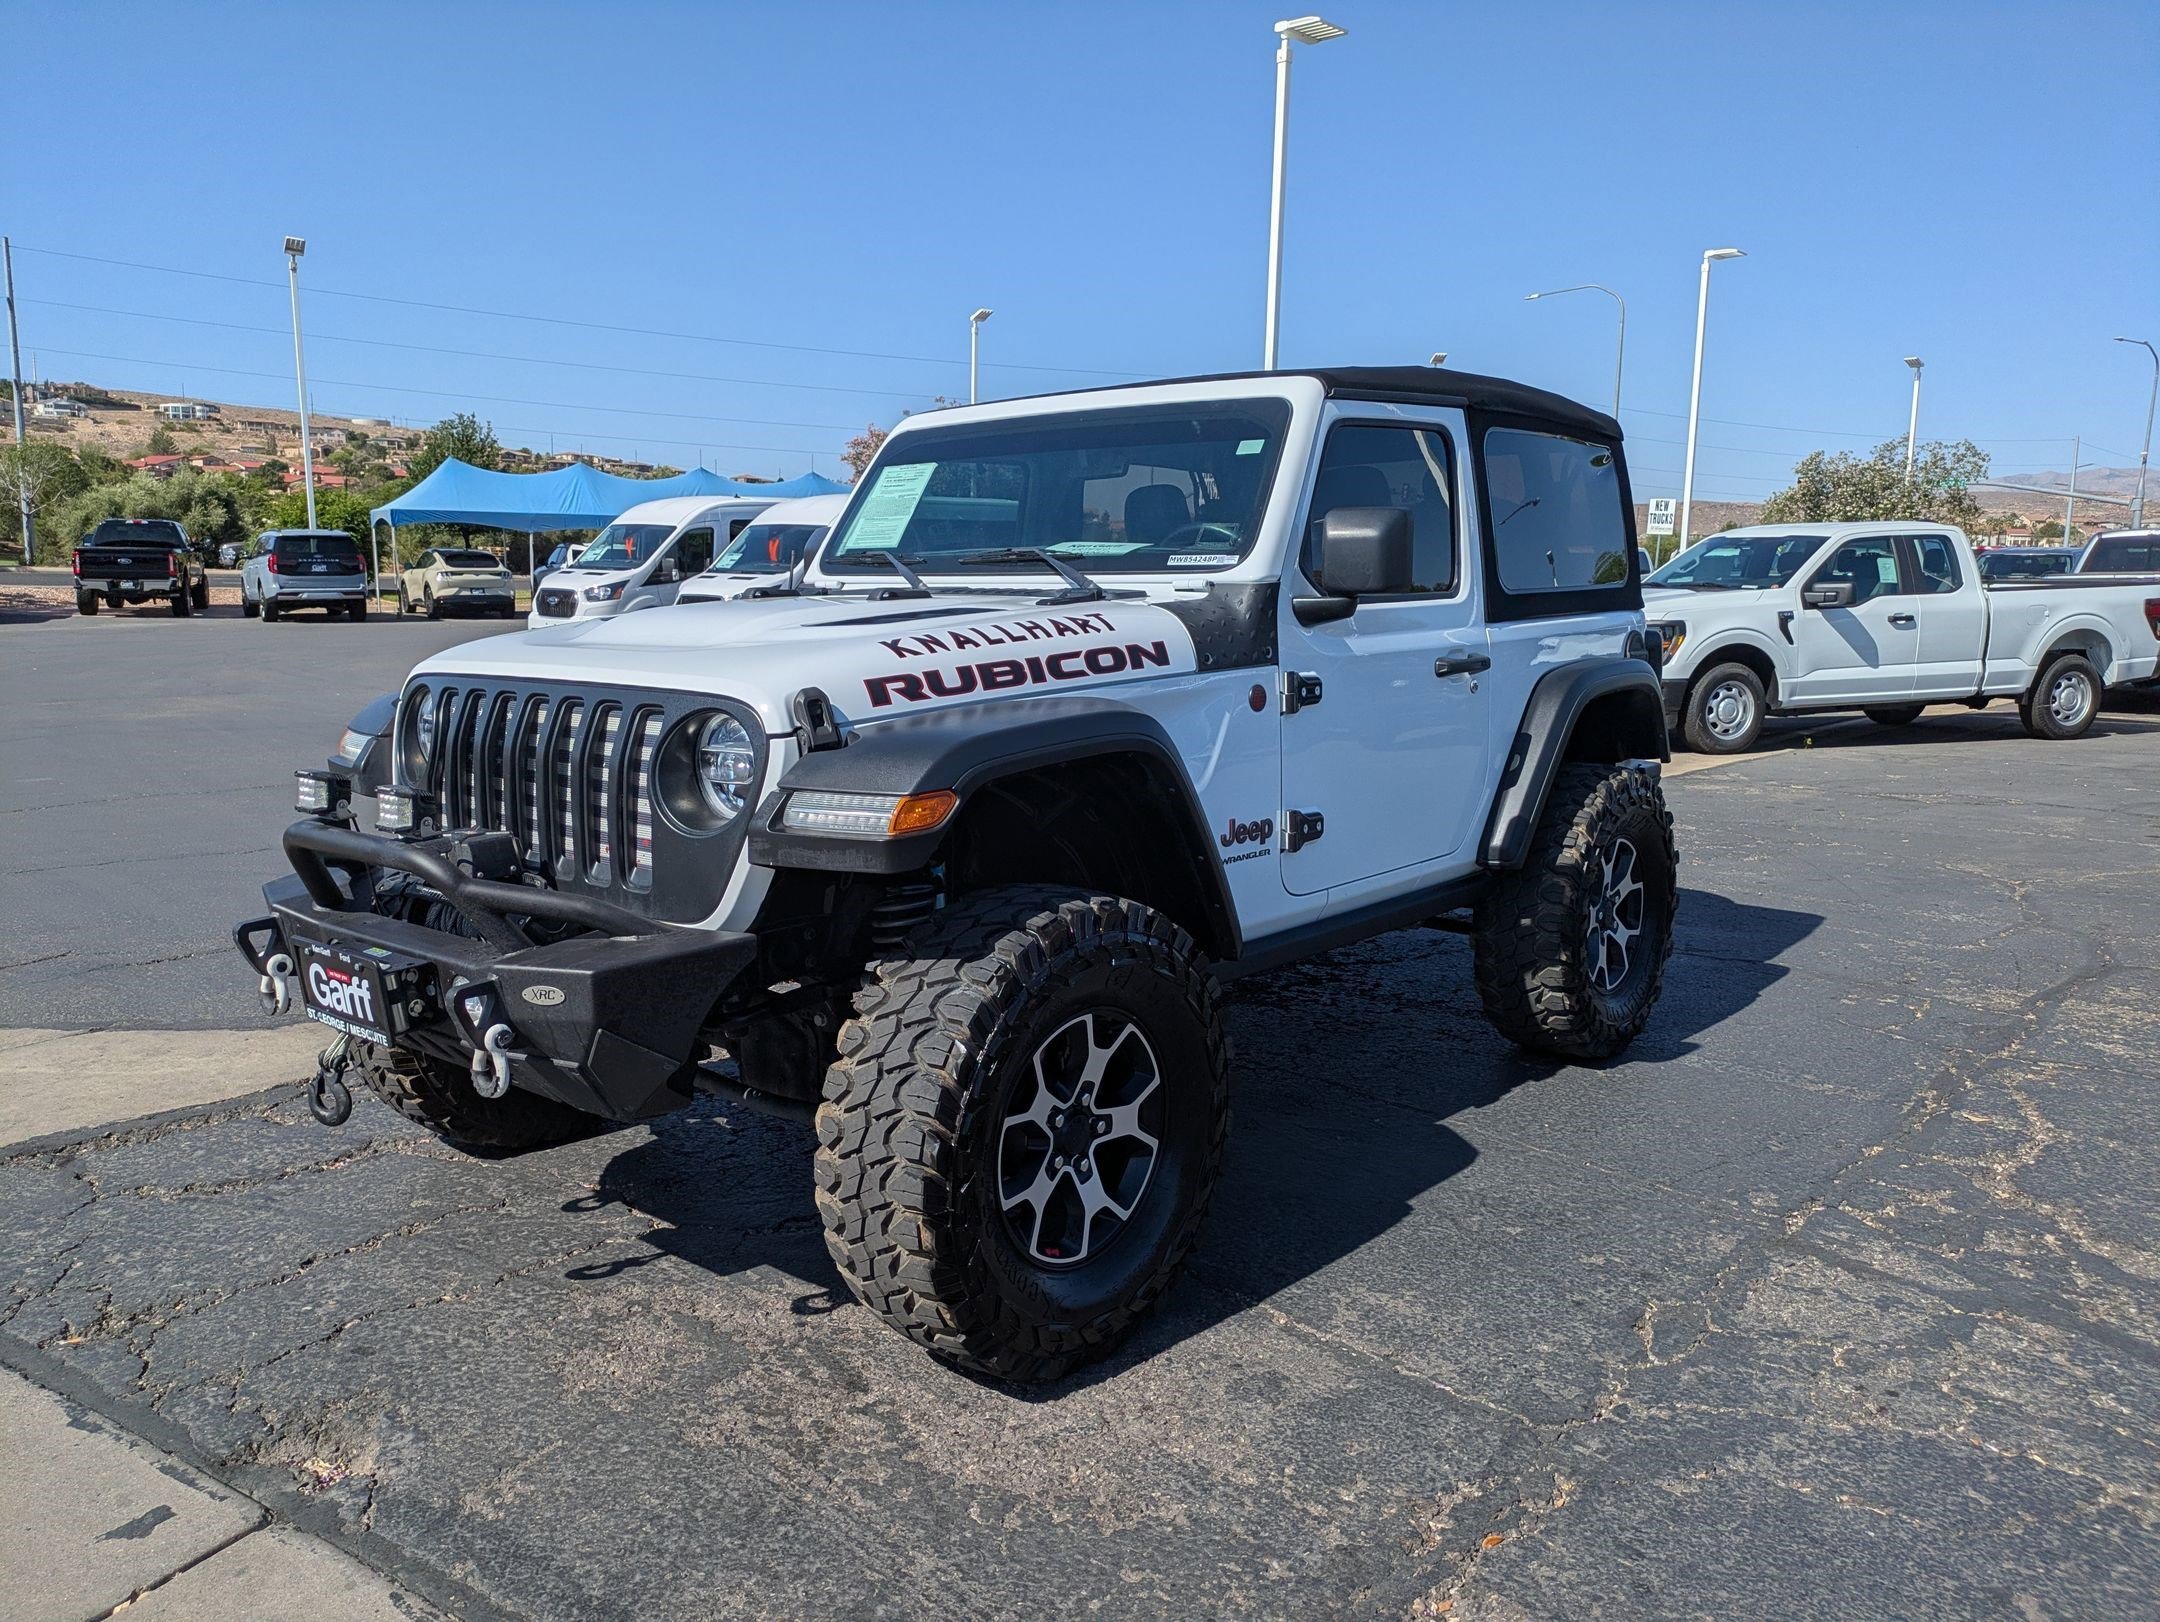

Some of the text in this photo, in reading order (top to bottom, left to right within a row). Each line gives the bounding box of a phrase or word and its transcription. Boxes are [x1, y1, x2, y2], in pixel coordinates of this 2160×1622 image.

[1655, 500, 1670, 511] NEW
[1650, 513, 1673, 524] TRUCKS
[878, 613, 1116, 658] KNALLHART
[863, 640, 1171, 708] RUBICON
[1220, 818, 1273, 847] Jeep
[1222, 848, 1271, 865] WRANGLER
[309, 962, 374, 1023] Garff
[531, 988, 556, 1001] XRC
[306, 1007, 318, 1021] ST.
